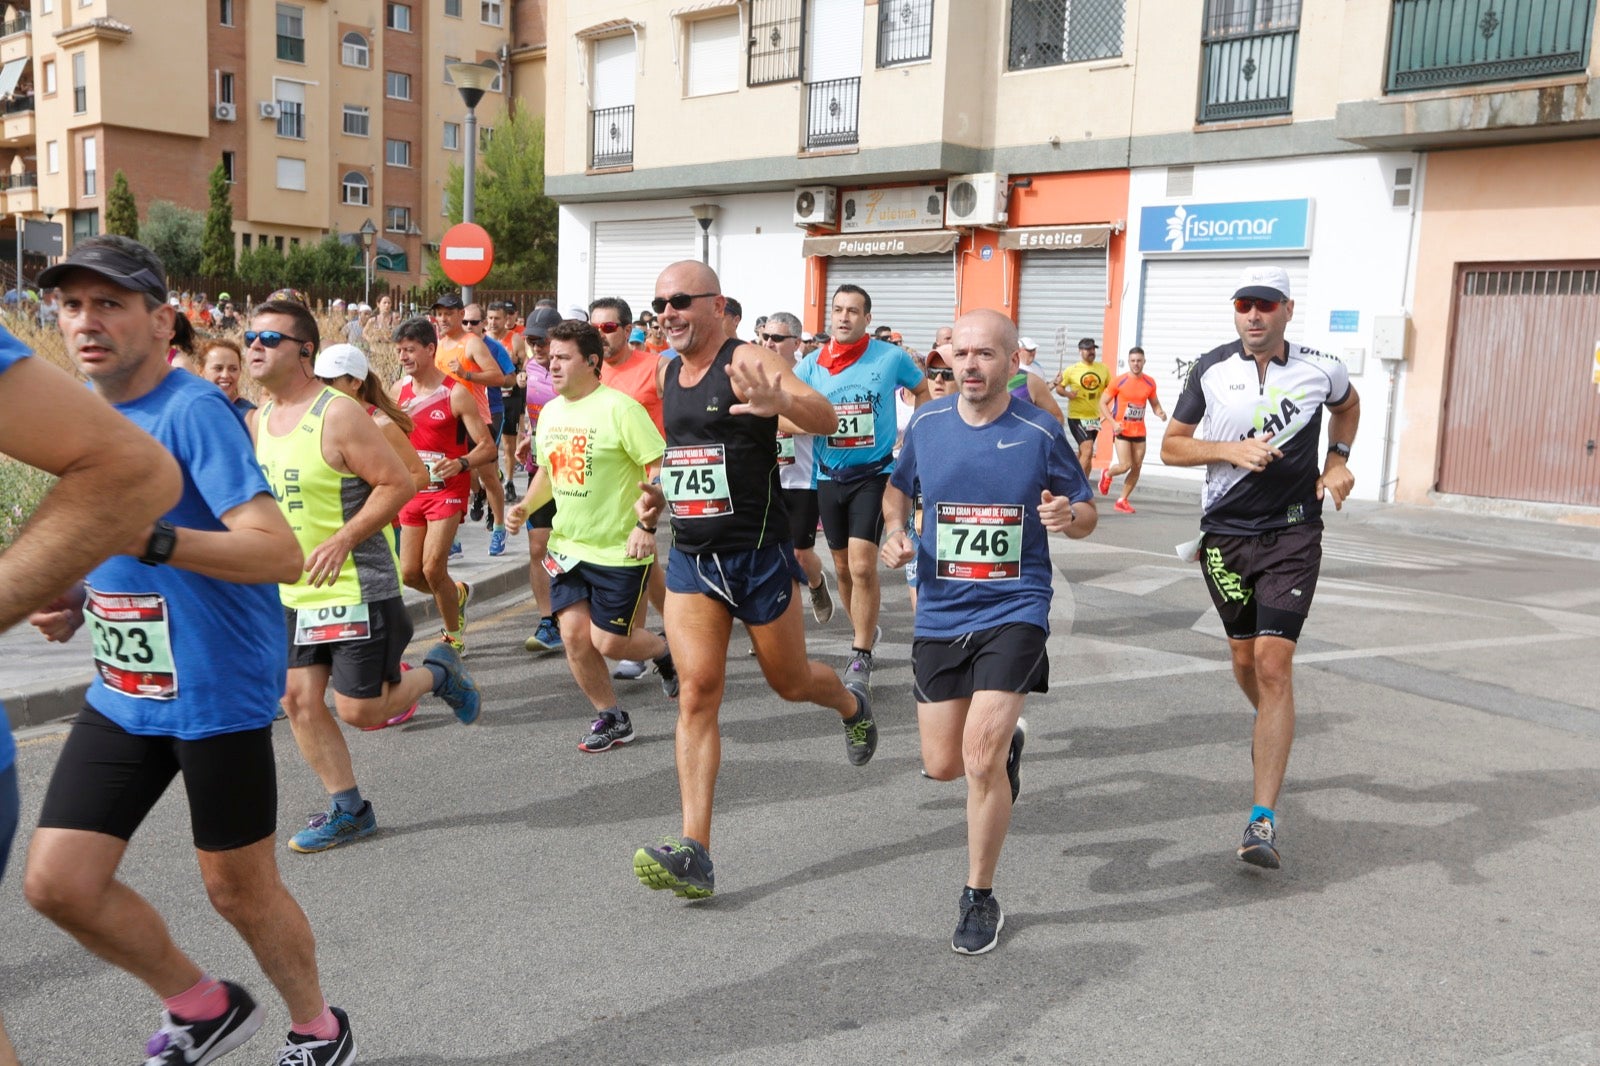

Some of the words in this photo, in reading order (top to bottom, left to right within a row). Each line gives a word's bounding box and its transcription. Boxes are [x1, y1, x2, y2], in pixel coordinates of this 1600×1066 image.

[1019, 232, 1082, 246] Estetica
[1185, 214, 1279, 242] fisiomar
[838, 239, 905, 254] Peluqueria
[588, 427, 598, 440] FE
[567, 435, 587, 486] 2018
[585, 443, 594, 477] SANTA
[670, 469, 716, 496] 745
[956, 506, 971, 517] GRAN
[971, 507, 992, 517] PREMIO
[992, 507, 1000, 517] DE
[1000, 508, 1018, 518] FONDO
[951, 528, 1010, 558] 746
[94, 620, 154, 665] 323
